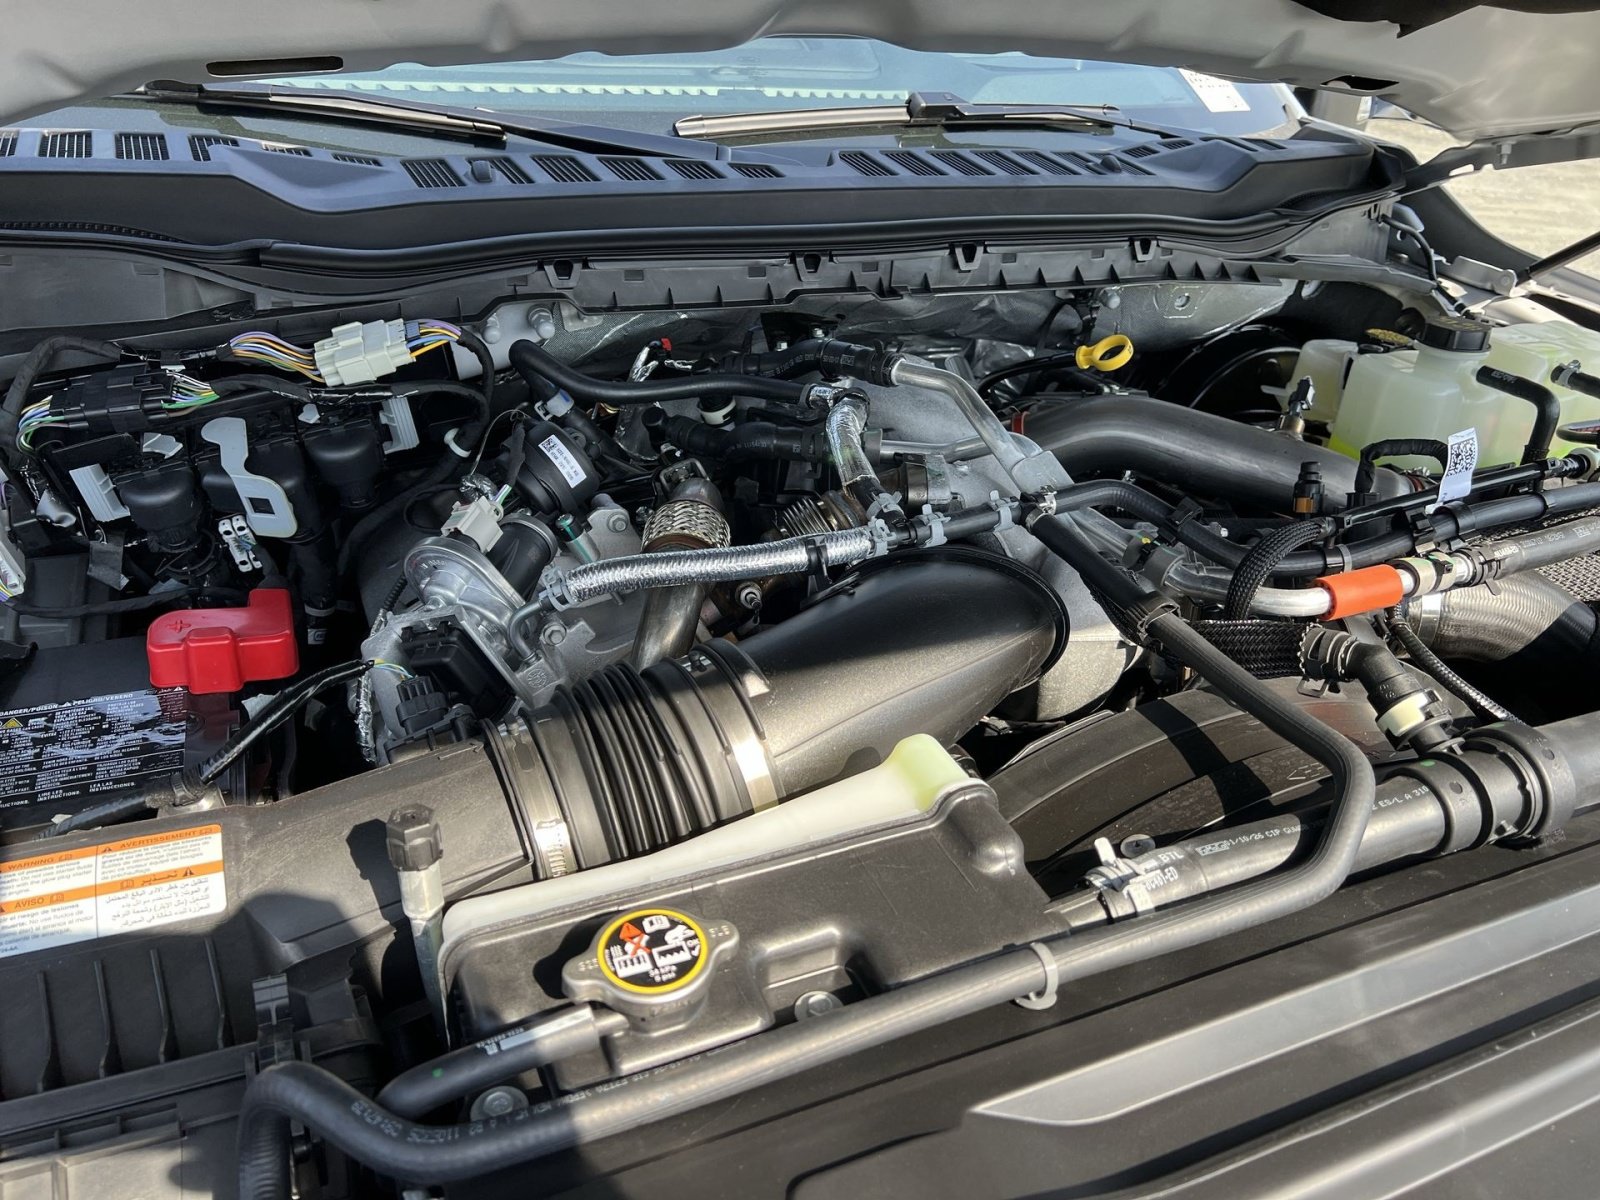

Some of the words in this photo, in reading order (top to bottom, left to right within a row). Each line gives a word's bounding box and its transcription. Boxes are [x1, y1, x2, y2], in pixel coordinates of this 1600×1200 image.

[120, 829, 197, 849] AVERTISSEMENT
[1158, 851, 1184, 863] BTL
[8, 857, 54, 871] WARNING
[15, 897, 45, 909] AVISO
